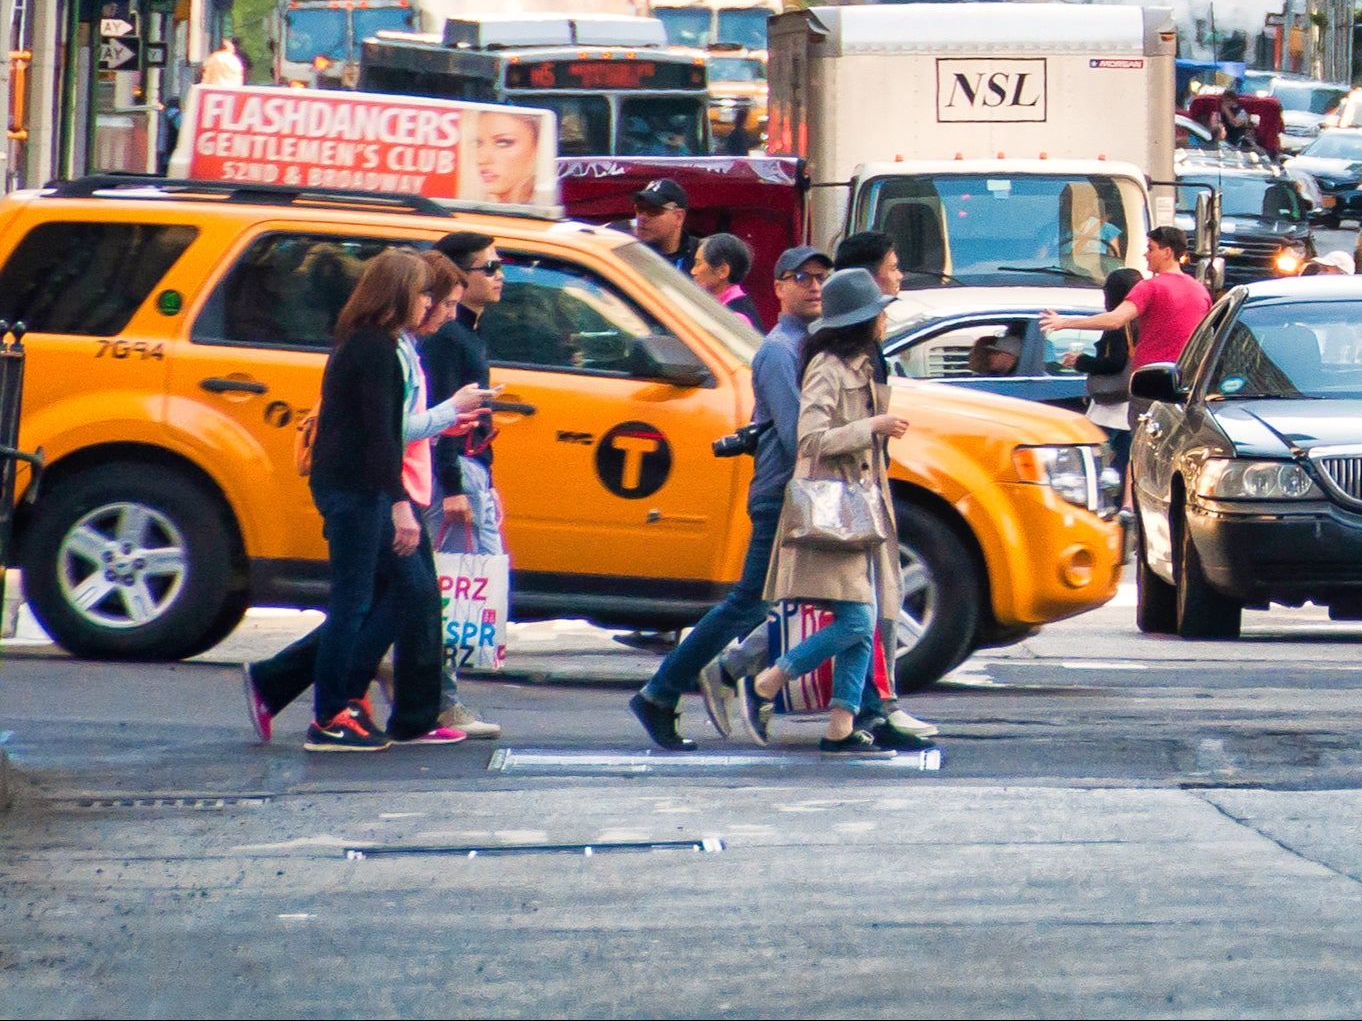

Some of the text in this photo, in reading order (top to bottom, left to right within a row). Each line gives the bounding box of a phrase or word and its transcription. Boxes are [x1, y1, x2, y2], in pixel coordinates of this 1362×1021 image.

[944, 72, 1041, 108] NSL
[202, 93, 461, 147] FLASHDANCERS
[197, 132, 456, 174] GENTLEMEN'S CLUB
[222, 161, 427, 195] 52ND & BROADWAY
[446, 621, 496, 647] SPR
